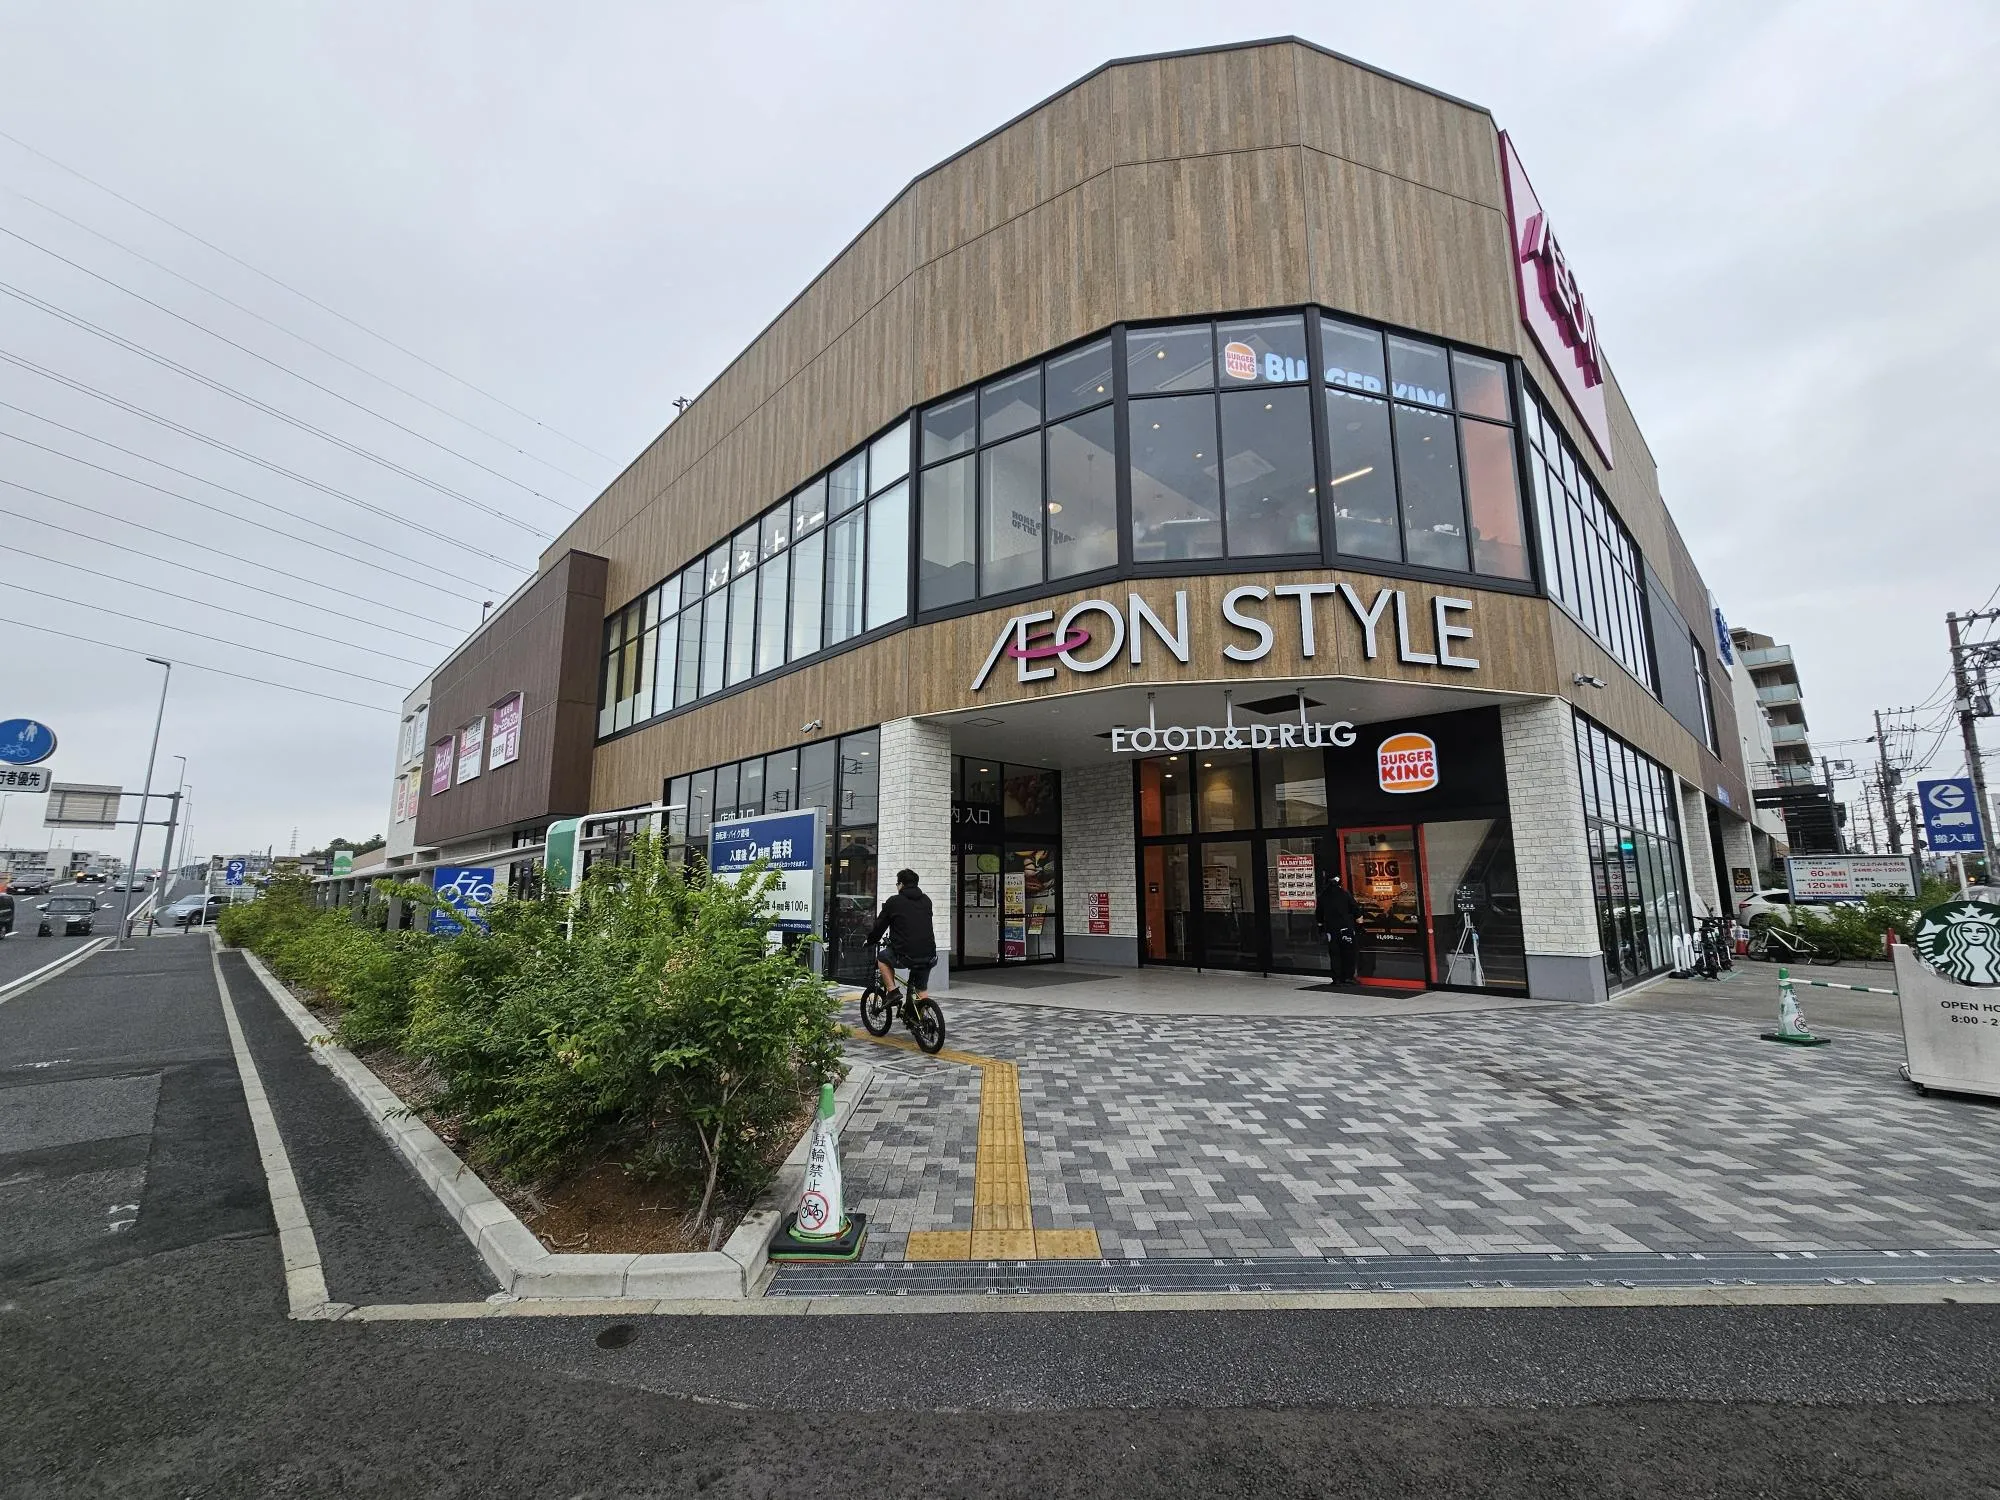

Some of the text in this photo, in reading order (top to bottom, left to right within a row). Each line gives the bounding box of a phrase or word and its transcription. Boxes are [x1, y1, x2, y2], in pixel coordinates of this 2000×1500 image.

[1226, 351, 1255, 363] BURGER
[1227, 360, 1255, 372] KING
[1265, 352, 1383, 405] BUGER
[1221, 583, 1481, 670] STYLE
[1111, 721, 1358, 753] FOOD&DRUG
[1380, 750, 1434, 765] BURGER
[1381, 762, 1435, 781] KING
[1933, 832, 1977, 844] 搬入車
[1363, 860, 1399, 877] BIG
[1940, 1001, 1979, 1011] OPEN
[1951, 1015, 1978, 1024] 8:00
[806, 1133, 826, 1193] 駐輪禁止
